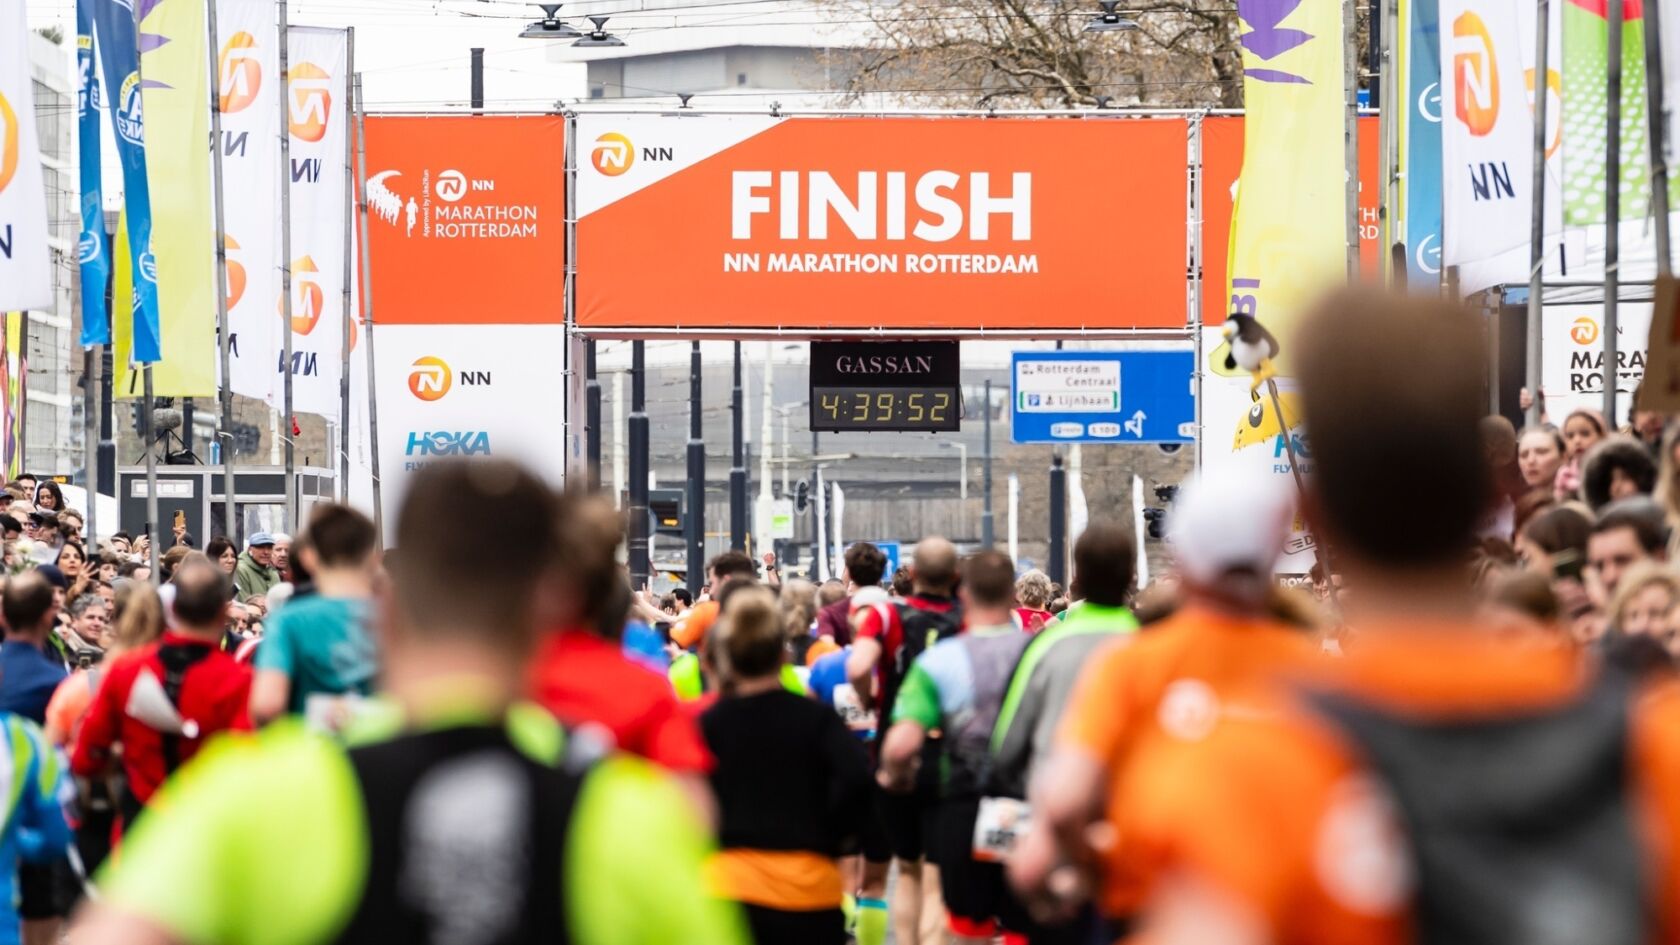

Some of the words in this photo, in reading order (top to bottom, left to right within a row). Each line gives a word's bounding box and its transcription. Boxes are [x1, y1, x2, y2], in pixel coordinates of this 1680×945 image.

[643, 147, 673, 161] NN
[472, 180, 495, 191] NN
[435, 205, 537, 220] MARATHON
[732, 170, 1031, 242] FINISH
[435, 223, 537, 238] ROTTERDAM
[724, 253, 760, 273] NN
[767, 253, 898, 273] MARATHON
[905, 253, 1039, 274] ROTTERDAM
[836, 355, 933, 375] GASSAN
[1570, 350, 1648, 369] MARA
[1036, 364, 1101, 374] Rotterdam
[460, 371, 491, 386] NN
[1065, 376, 1117, 387] Centraal
[821, 393, 949, 422] 4:39:52
[1059, 395, 1111, 407] Lijnbaan
[405, 431, 491, 456] HOKA
[1273, 463, 1291, 474] FLY
